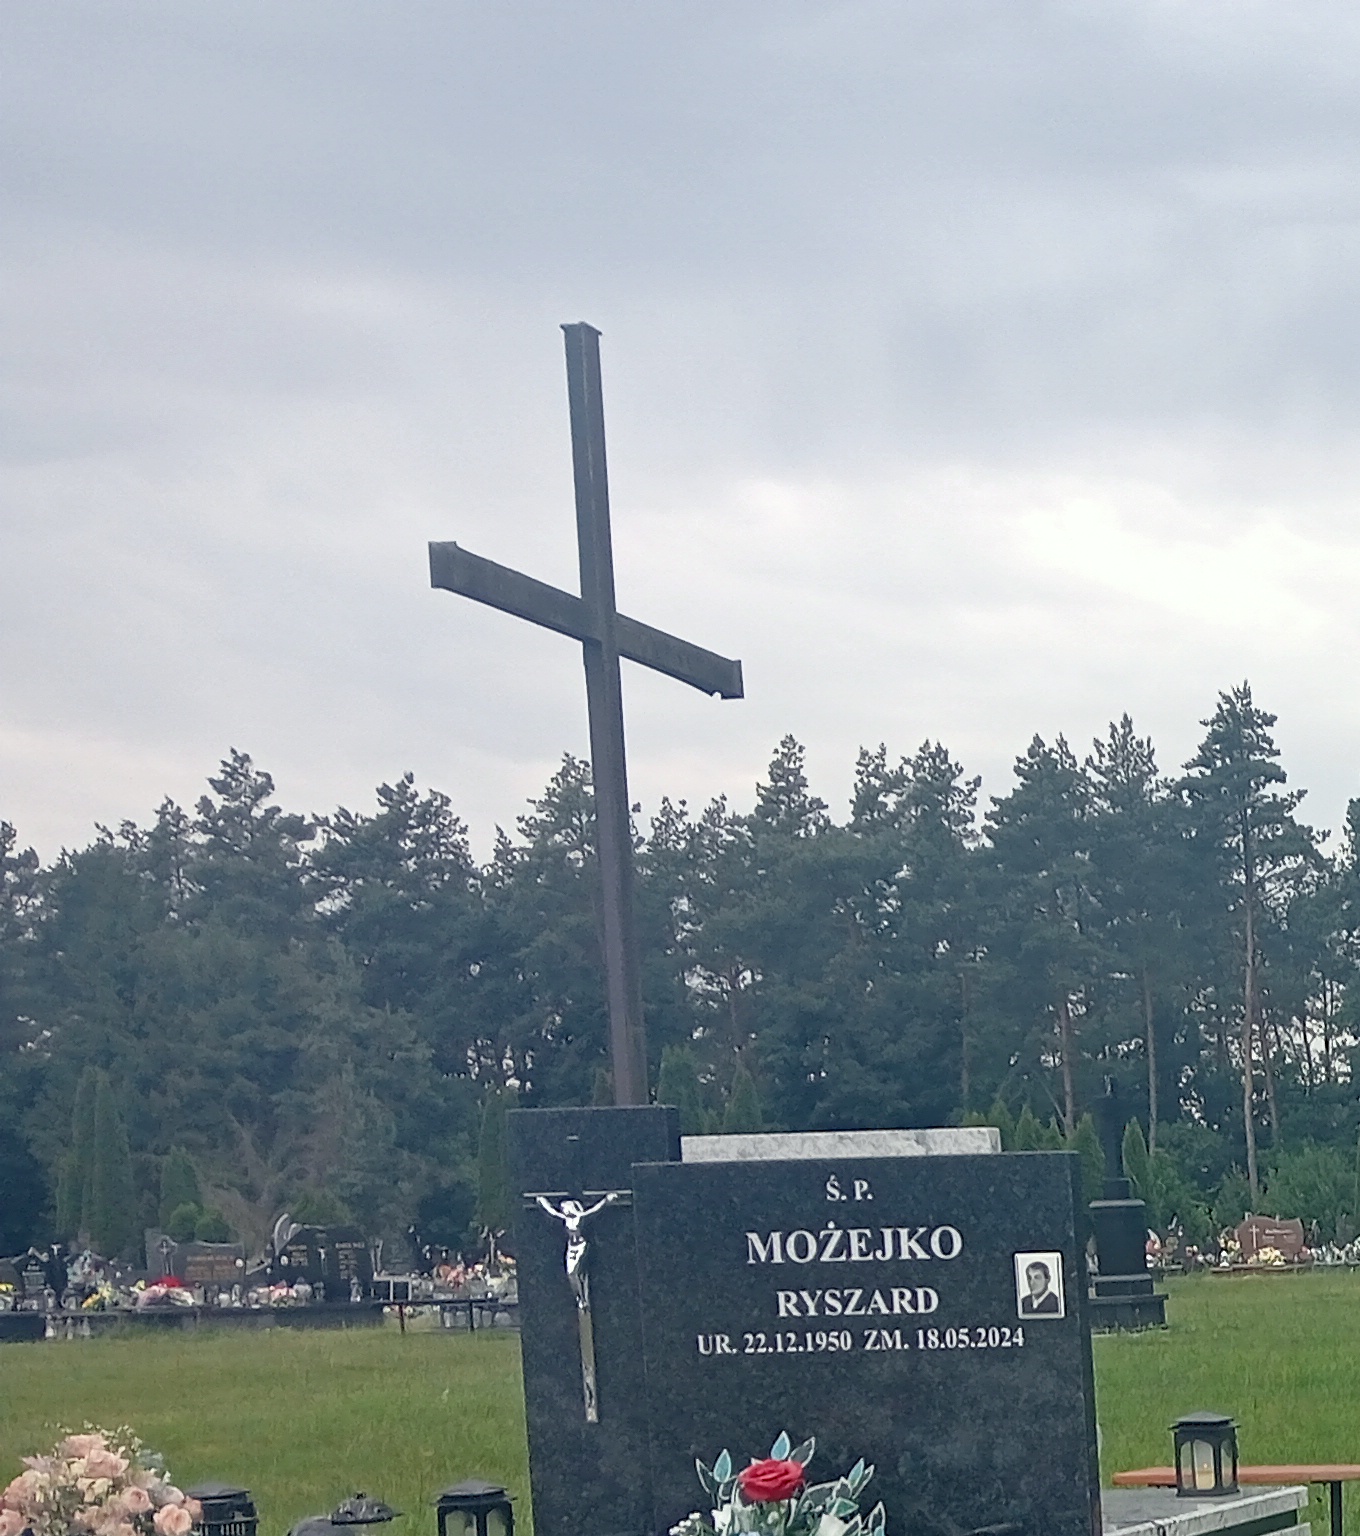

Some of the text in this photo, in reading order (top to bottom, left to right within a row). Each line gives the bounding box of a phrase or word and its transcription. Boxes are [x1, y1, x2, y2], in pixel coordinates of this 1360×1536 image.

[745, 1220, 964, 1264] MOŻEJKO
[776, 1286, 940, 1318] RYSZARD
[697, 1326, 1026, 1356] UR. 22.12.1950 ZM. 18.05.2024
